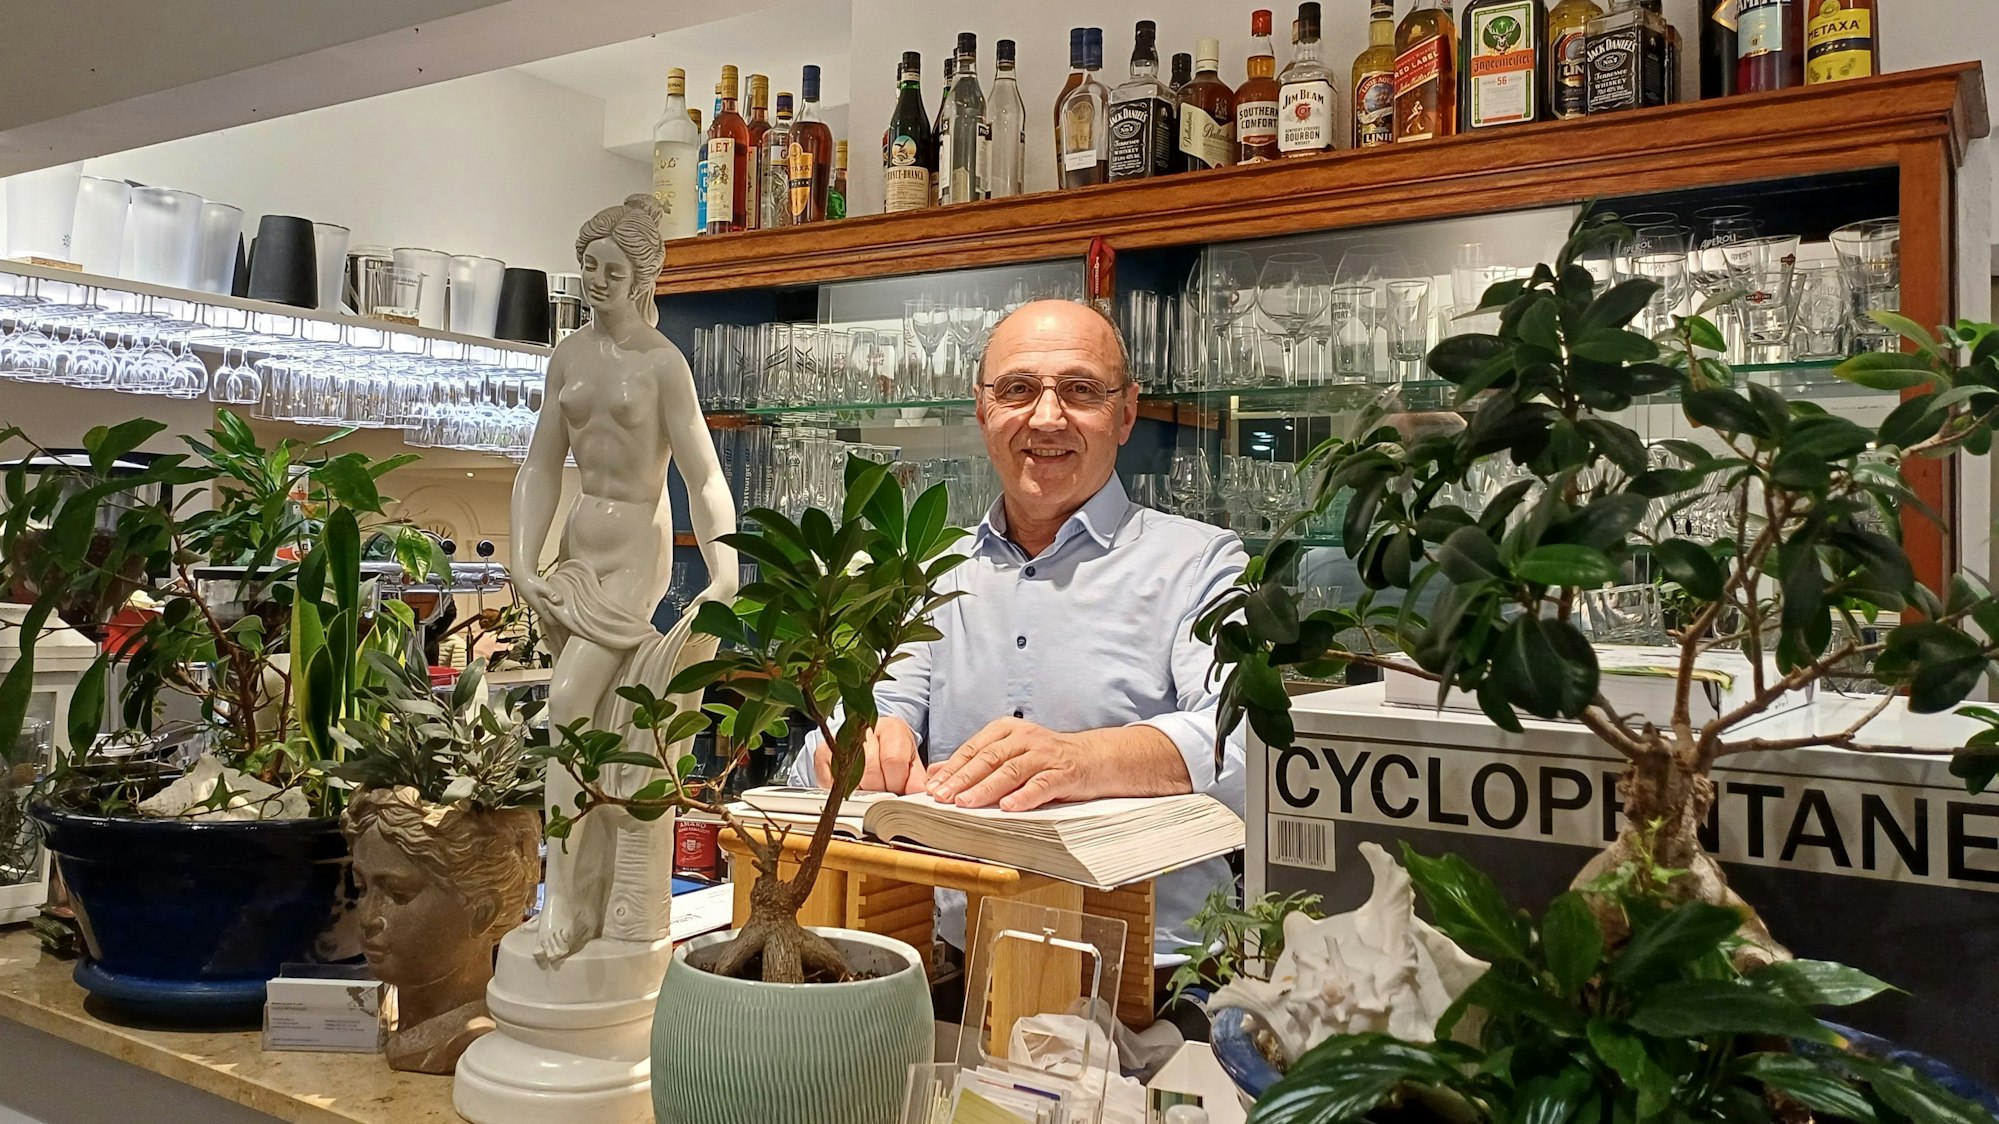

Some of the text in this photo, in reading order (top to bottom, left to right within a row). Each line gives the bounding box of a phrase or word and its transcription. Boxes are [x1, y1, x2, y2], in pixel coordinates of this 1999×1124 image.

[1808, 20, 1860, 39] METAXA
[1587, 38, 1637, 62] JACK DANIEL'S
[1394, 65, 1410, 79] RED
[1411, 51, 1439, 69] LABEL
[1563, 65, 1585, 76] LIN
[1497, 76, 1507, 85] 56
[1595, 78, 1627, 89] WHISKEY
[1283, 89, 1324, 109] JIM BEAM
[1109, 108, 1148, 127] JACK DANIEL'S
[1242, 119, 1277, 129] COMFORT
[1285, 131, 1320, 142] BOURBON
[1621, 240, 1653, 255] APEROL
[1700, 234, 1735, 249] APEROL
